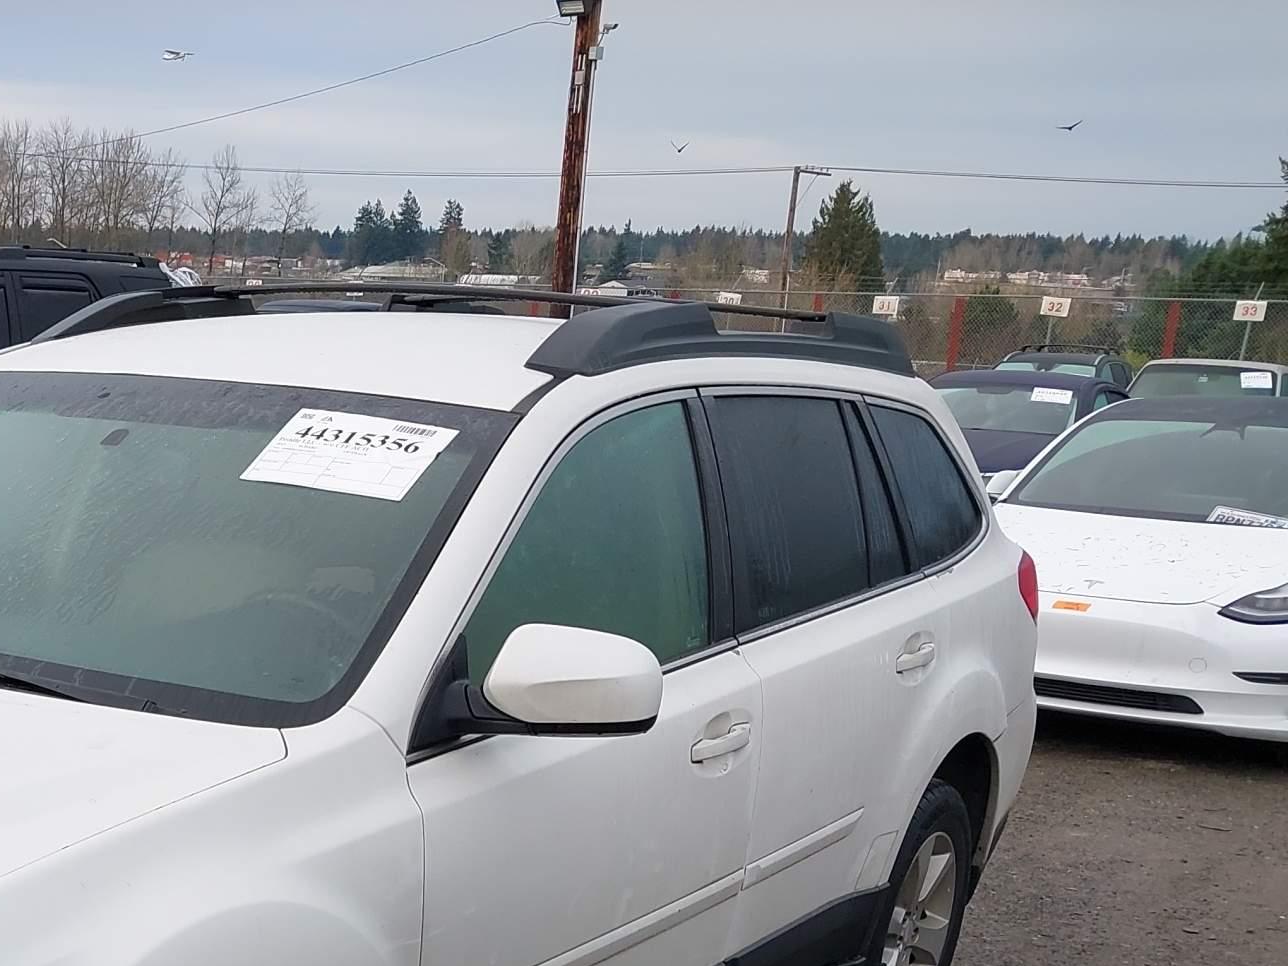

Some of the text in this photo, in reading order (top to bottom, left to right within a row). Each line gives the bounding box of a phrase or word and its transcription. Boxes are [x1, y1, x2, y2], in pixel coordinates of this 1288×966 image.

[1047, 301, 1063, 313] 32
[1241, 306, 1257, 317] 33
[295, 425, 424, 454] 44315356
